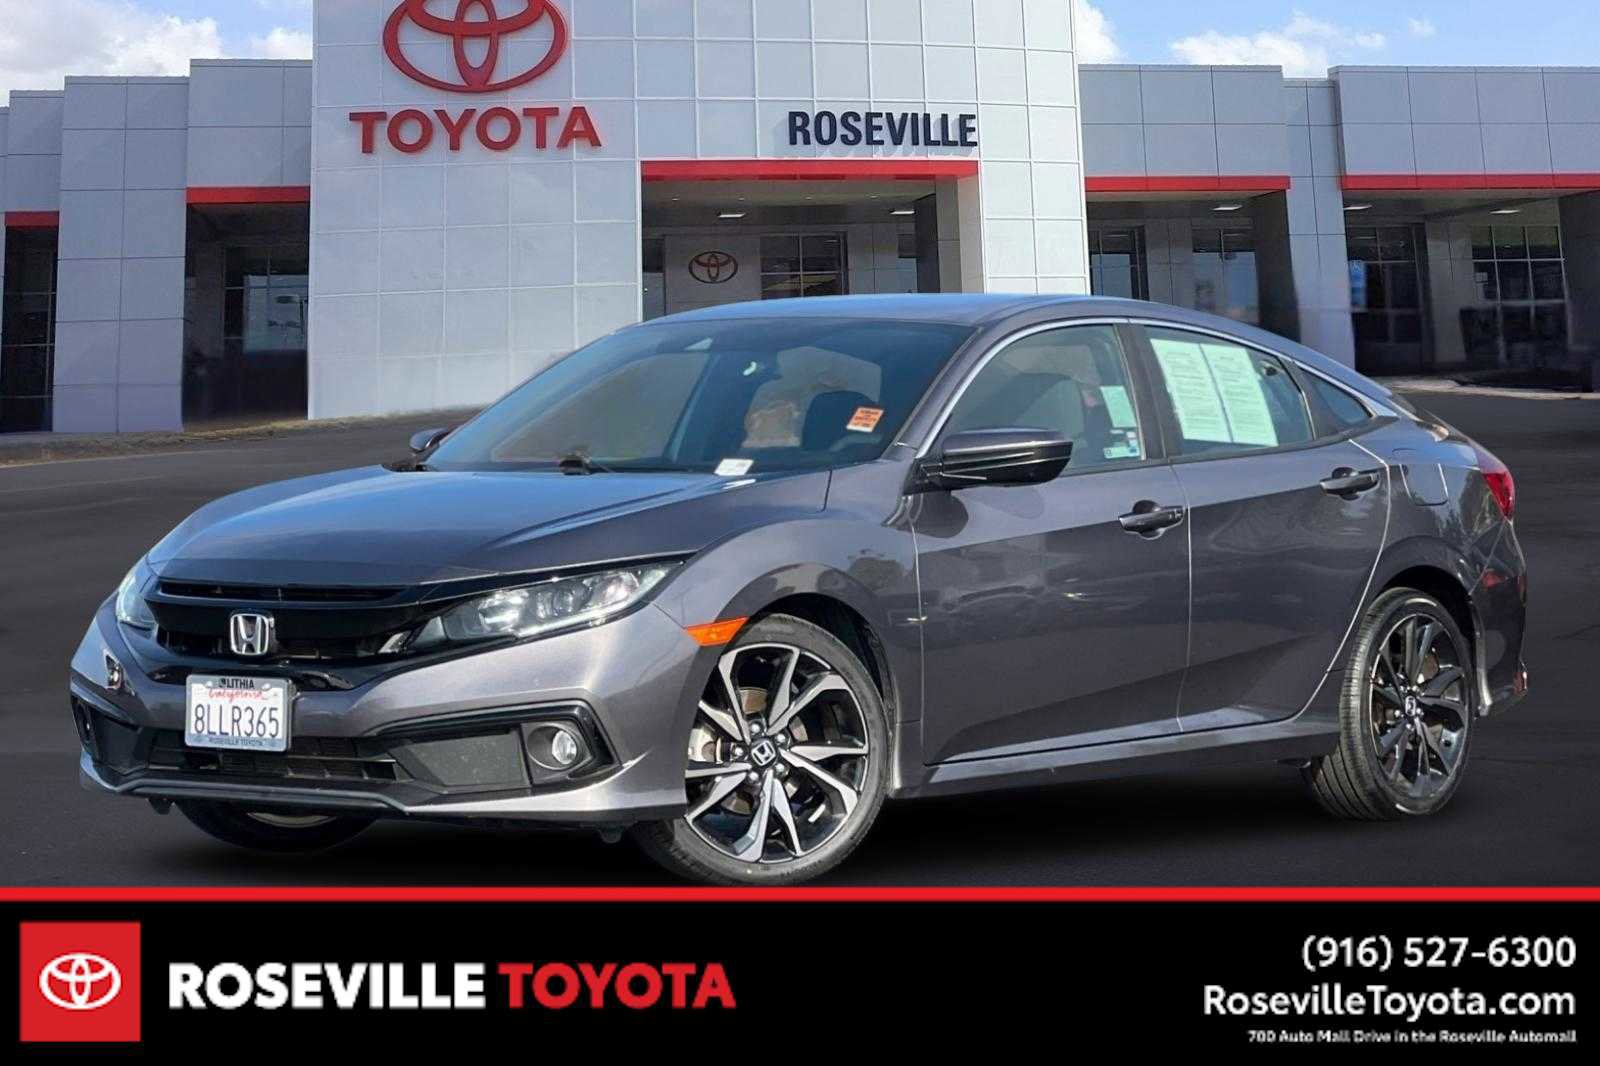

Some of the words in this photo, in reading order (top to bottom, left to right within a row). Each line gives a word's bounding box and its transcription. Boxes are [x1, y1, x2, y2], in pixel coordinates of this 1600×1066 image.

[349, 106, 602, 154] TOYOTA
[788, 111, 978, 147] ROSEVILLE
[227, 679, 255, 690] LITHIA
[194, 704, 280, 738] 8LLR365
